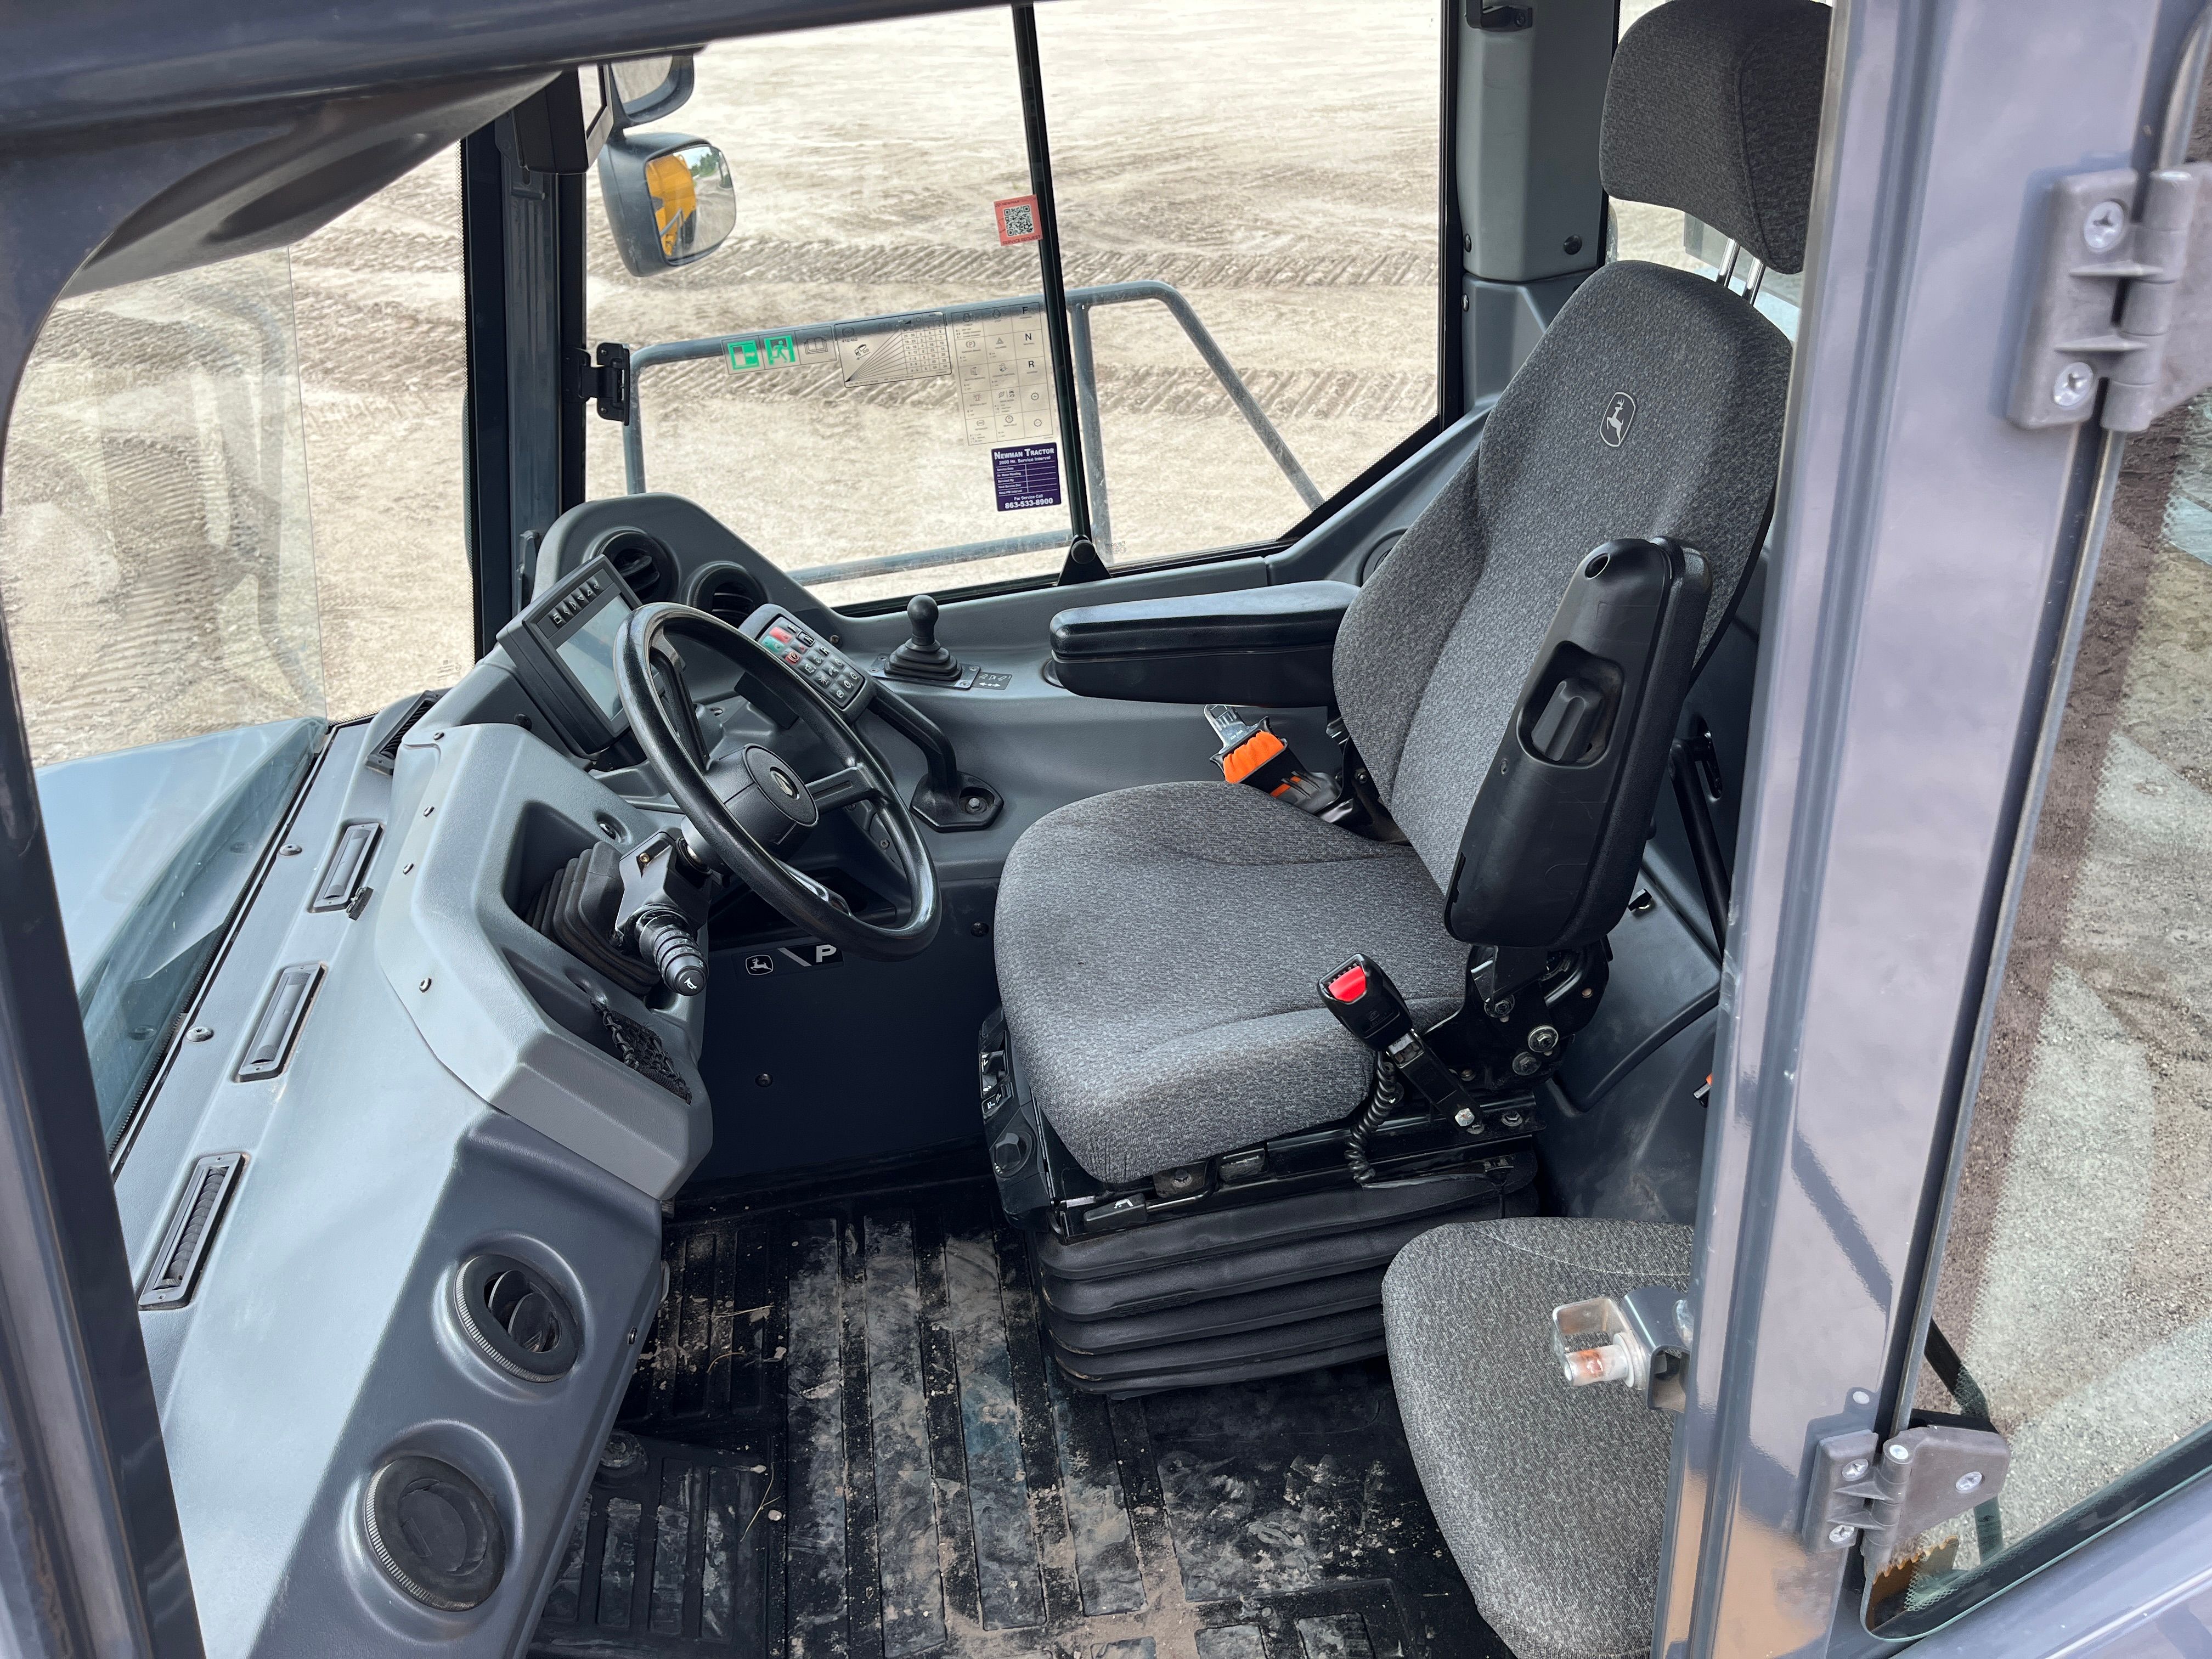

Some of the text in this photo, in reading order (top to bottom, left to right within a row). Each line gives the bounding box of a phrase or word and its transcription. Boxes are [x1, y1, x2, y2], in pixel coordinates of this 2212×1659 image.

[994, 448, 1054, 460] NEWMAN TRACTOR
[1005, 498, 1053, 509] 863-533-8900
[804, 634, 814, 644] N
[816, 944, 837, 963] P
